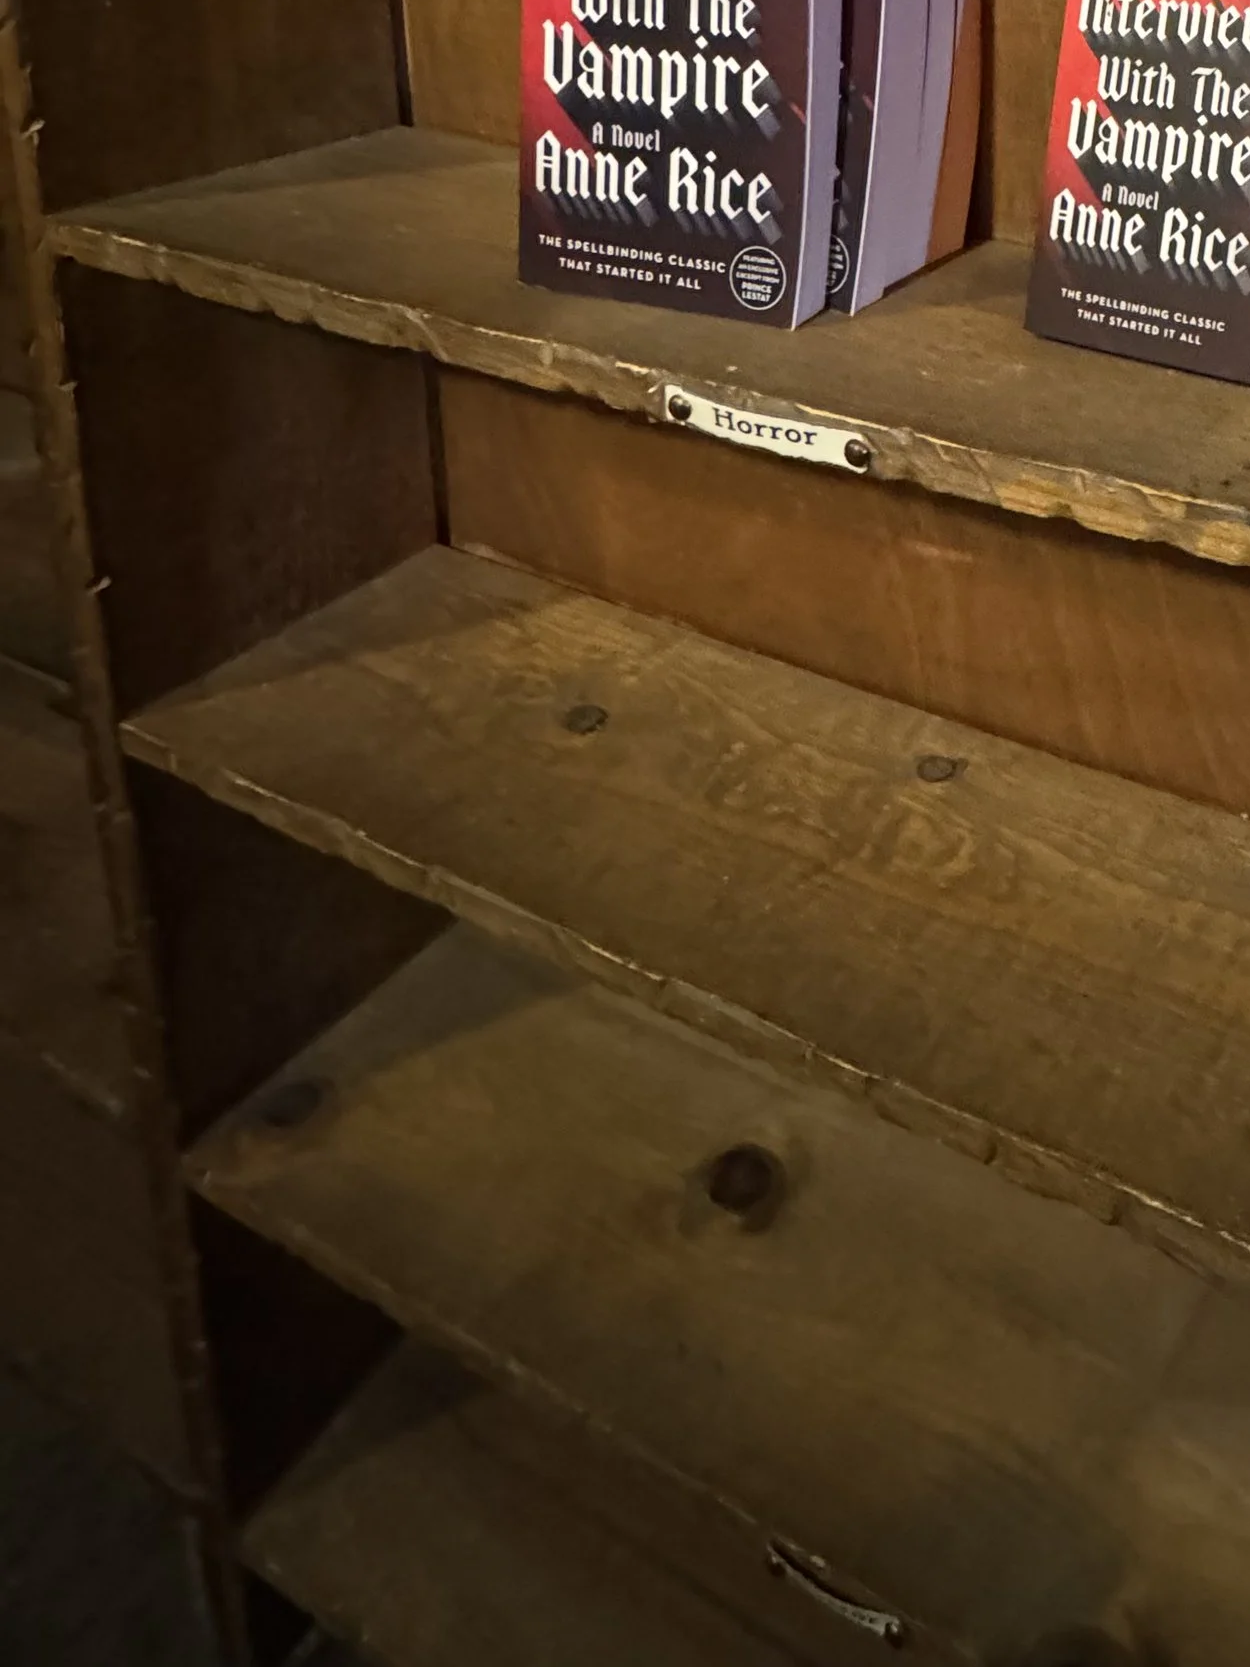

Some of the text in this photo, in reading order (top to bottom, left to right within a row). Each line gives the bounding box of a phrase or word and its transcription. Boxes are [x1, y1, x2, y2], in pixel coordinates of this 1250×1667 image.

[542, 19, 770, 120] Vampire
[1097, 53, 1175, 110] With
[592, 122, 661, 152] A Novel
[535, 129, 773, 224] Anne Rice
[1101, 182, 1160, 211] A Novel
[1049, 188, 1250, 277] Anne Rice
[538, 233, 726, 274] THE SPELLBINDING CLASSIC
[558, 257, 702, 290] THAT STARTED IT ALL
[741, 281, 772, 294] PRINCE
[741, 291, 771, 302] LESTAT
[1060, 287, 1226, 332] THE SPELLBINDING CLASSIC
[1077, 308, 1202, 346] THAT STARTED IT ALL
[712, 407, 818, 446] Horror
